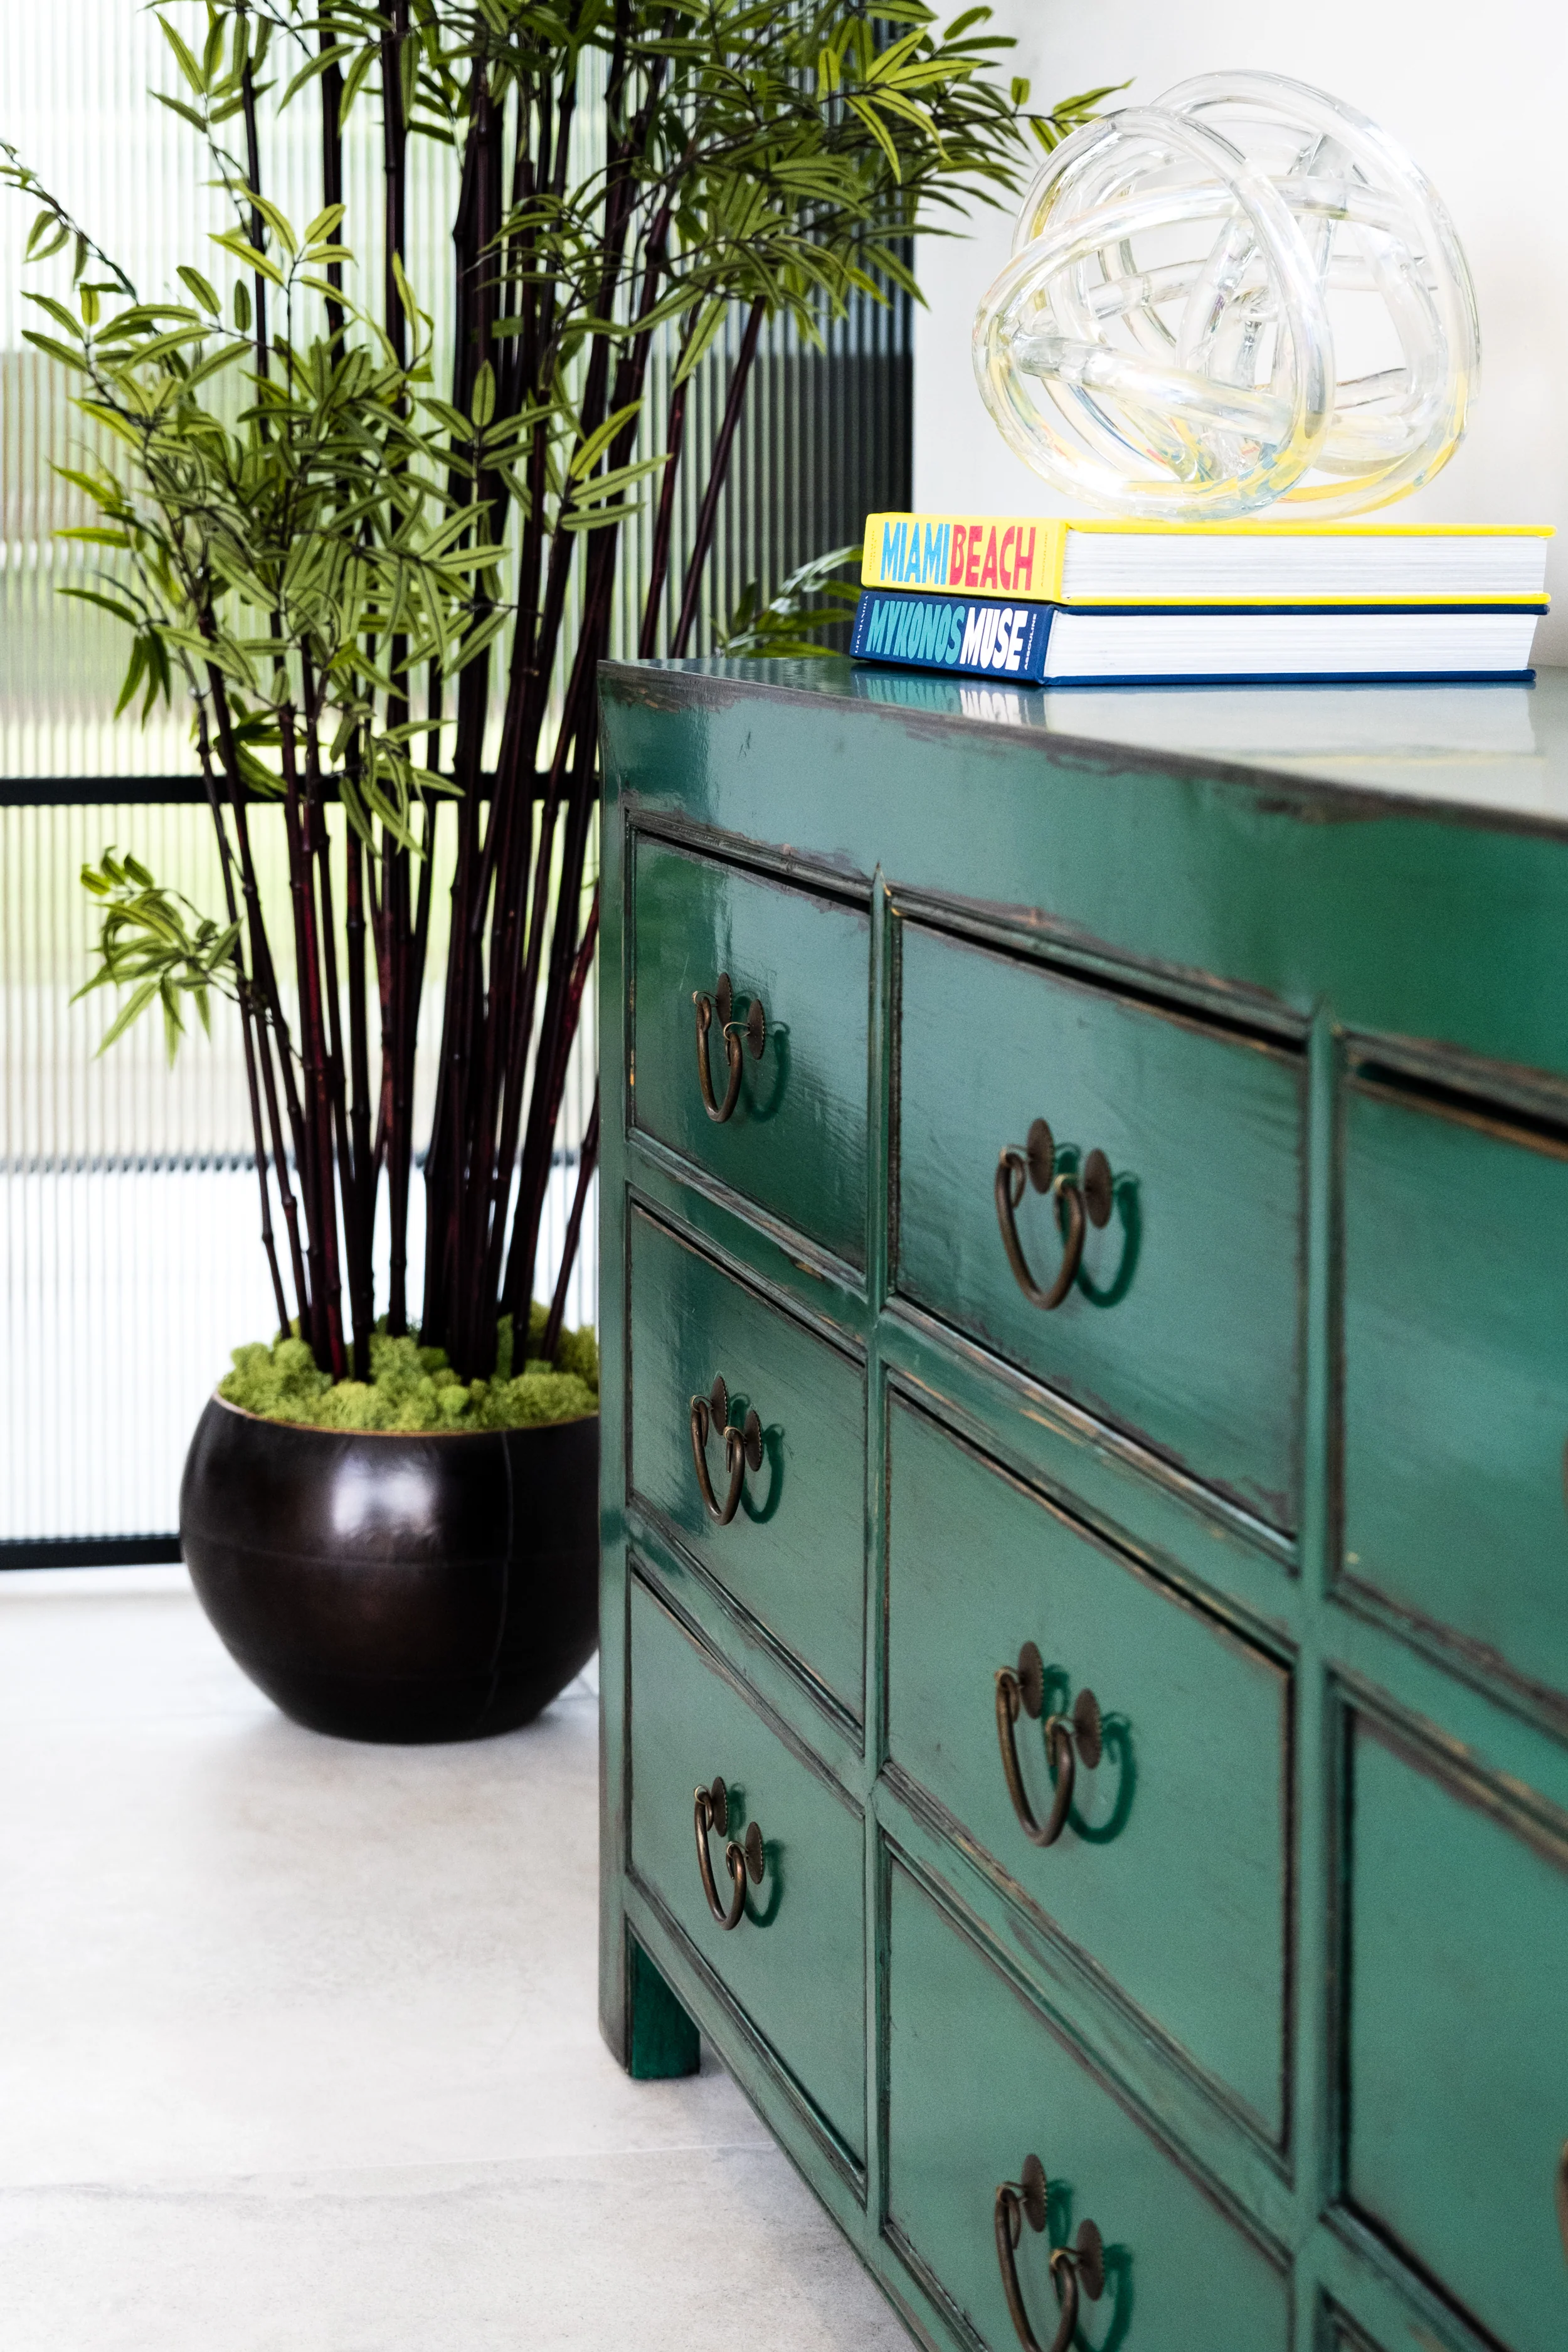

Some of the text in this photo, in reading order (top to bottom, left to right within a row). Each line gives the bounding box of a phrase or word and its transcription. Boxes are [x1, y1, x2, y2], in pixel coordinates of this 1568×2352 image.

[880, 521, 950, 585] MIAMI
[949, 524, 1036, 591] BEACH
[865, 600, 1029, 671] MYKONOS MUSE
[1024, 613, 1037, 670] ASSOULINE
